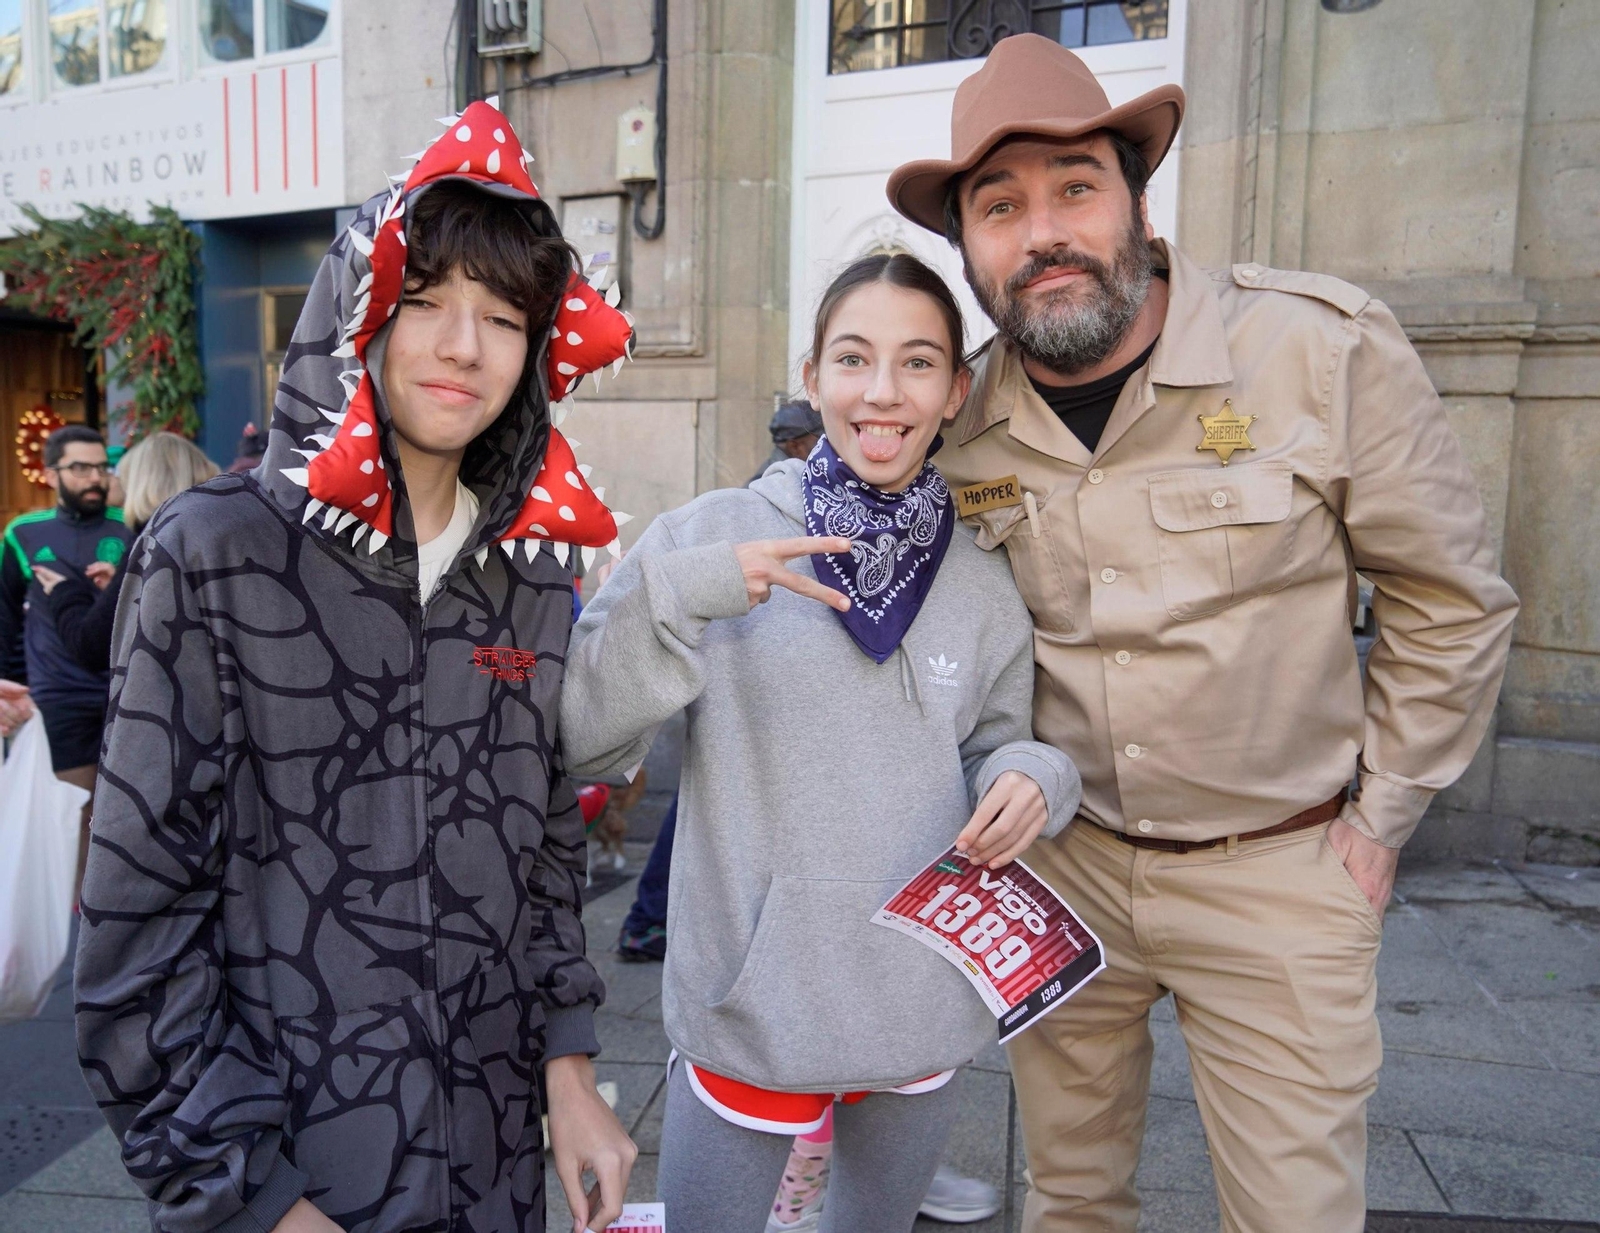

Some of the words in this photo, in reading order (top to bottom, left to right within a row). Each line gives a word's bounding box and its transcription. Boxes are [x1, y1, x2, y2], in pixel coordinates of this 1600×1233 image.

[56, 123, 204, 156] EDUCATIVOS
[39, 151, 206, 191] RAINBOW
[1207, 424, 1245, 440] SHERIFF
[964, 482, 1016, 506] HOPPER
[473, 651, 536, 669] STRANGER
[490, 667, 525, 681] THINGS
[928, 675, 958, 687] adidas
[1001, 875, 1049, 919] SILVESTRE
[916, 884, 1032, 980] 1389
[1041, 980, 1062, 1003] 1389
